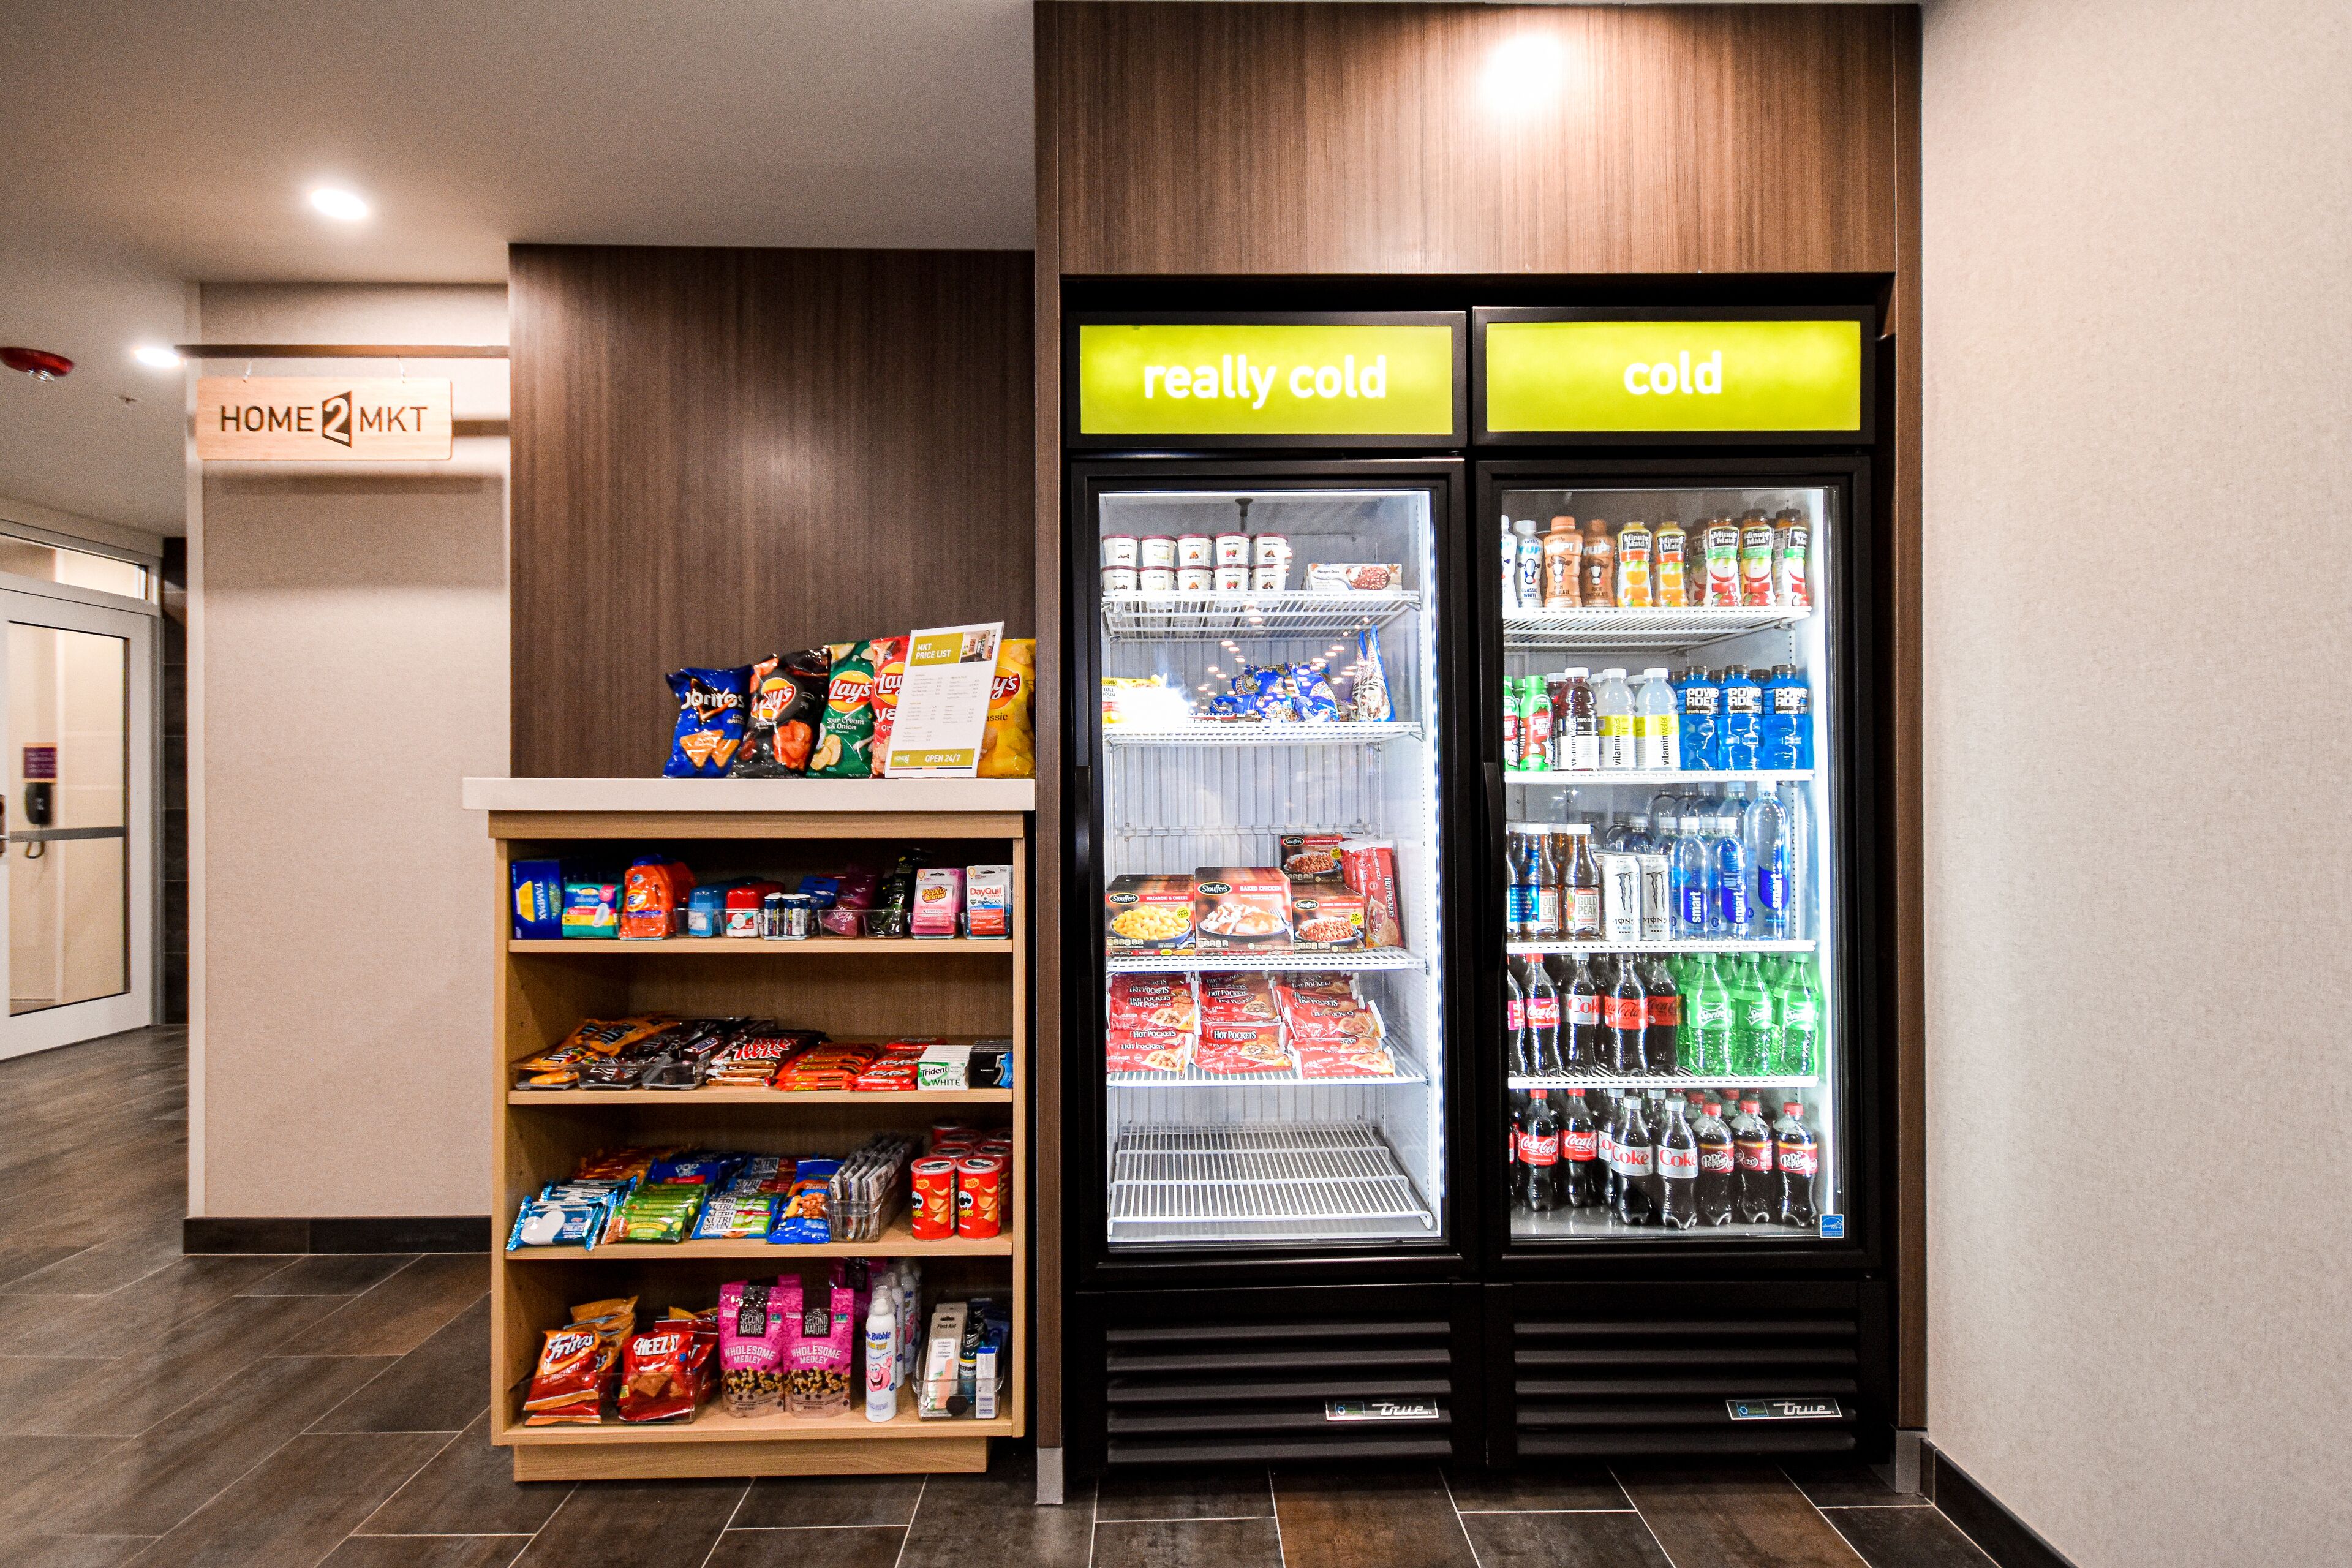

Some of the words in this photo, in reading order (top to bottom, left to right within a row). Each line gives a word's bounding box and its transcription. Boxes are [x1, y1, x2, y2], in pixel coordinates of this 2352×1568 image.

[1623, 350, 1722, 394] cold
[1144, 354, 1276, 409] really
[1288, 353, 1386, 399] cold
[221, 405, 314, 432] HOME
[360, 407, 428, 432] MKT
[915, 650, 937, 660] PRICE
[937, 649, 951, 658] LIST
[828, 680, 872, 704] Lay's
[1611, 716, 1621, 766] vitaminwater
[1661, 716, 1670, 766] vitaminwater
[925, 755, 945, 763] OPEN
[944, 754, 961, 763] 24/7
[970, 888, 1001, 897] DayQuil
[1201, 884, 1228, 893] Stouffer's
[534, 881, 548, 921] TAMPAX
[925, 891, 946, 902] Bismol
[1544, 897, 1556, 907] OLD
[1578, 897, 1597, 906] GOLD
[1387, 891, 1395, 918] POCKETS
[1689, 891, 1702, 923] smart
[1734, 891, 1744, 923] smart
[1543, 906, 1556, 916] EAK
[1578, 906, 1598, 915] PEAK
[1227, 1030, 1256, 1039] POCKETS
[921, 1066, 948, 1077] Trident
[993, 1055, 1006, 1085] 5
[1611, 1145, 1649, 1165] Coke
[1659, 1149, 1697, 1167] Coke
[1711, 1151, 1722, 1160] Dr
[1790, 1151, 1803, 1160] Dr
[1703, 1156, 1728, 1168] Pepper
[739, 1313, 764, 1324] SECOND
[804, 1313, 829, 1325] SECOND
[739, 1324, 763, 1335] NATURE
[804, 1324, 828, 1335] NATURE
[872, 1331, 891, 1341] Bubble
[547, 1333, 594, 1363] Fritos
[724, 1345, 776, 1360] WHOLESOME
[791, 1345, 842, 1359] WHOLESOME
[734, 1355, 763, 1365] MEDLEY
[799, 1355, 828, 1365] MEDLEY
